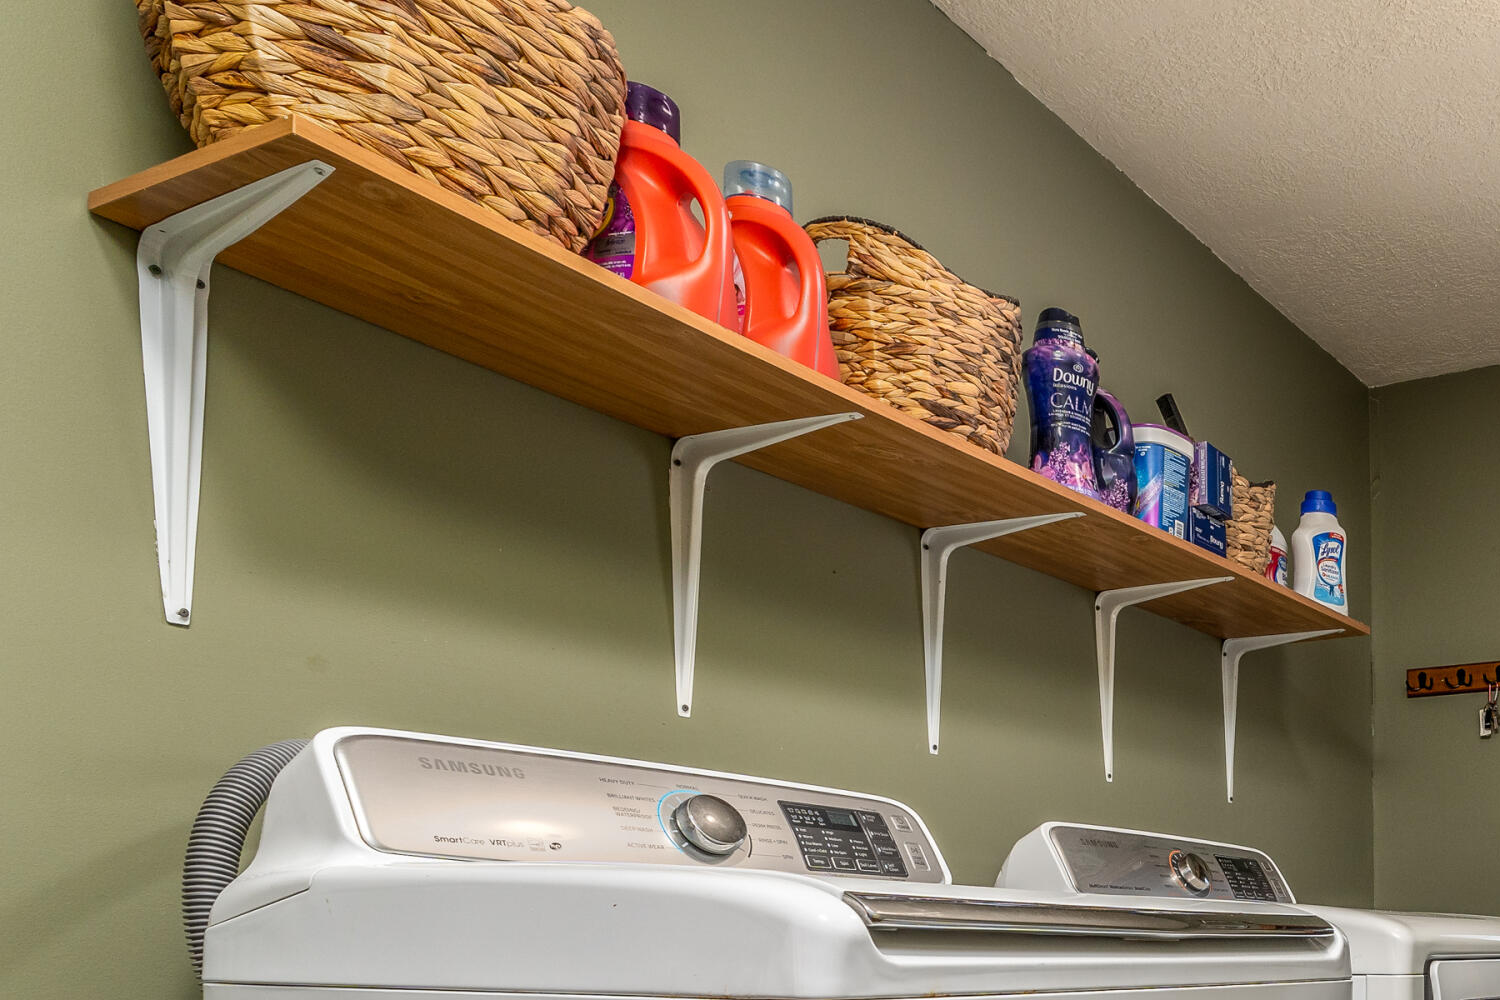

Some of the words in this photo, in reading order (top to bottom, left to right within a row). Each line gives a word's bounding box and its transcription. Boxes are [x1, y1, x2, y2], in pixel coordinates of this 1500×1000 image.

[1053, 367, 1094, 396] Downy
[1050, 392, 1092, 418] CALM
[418, 757, 525, 779] SAMSUNG
